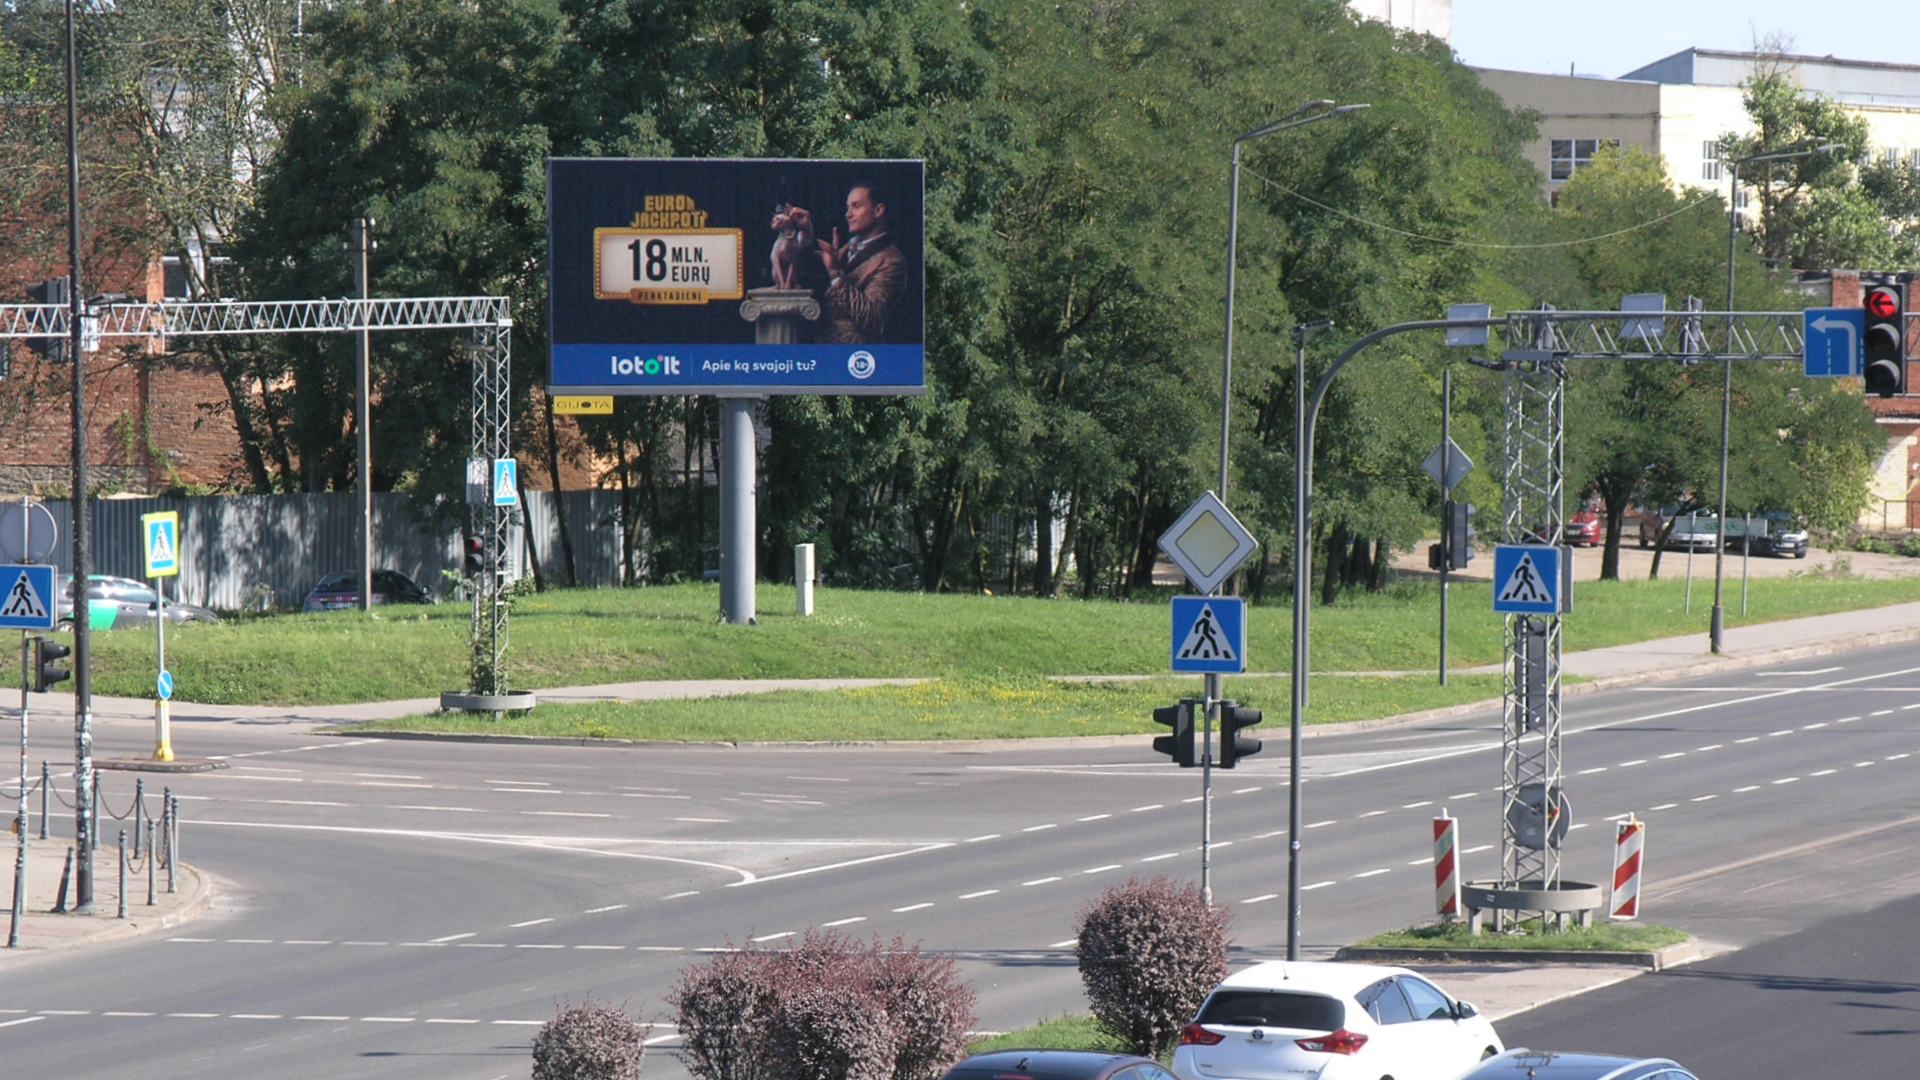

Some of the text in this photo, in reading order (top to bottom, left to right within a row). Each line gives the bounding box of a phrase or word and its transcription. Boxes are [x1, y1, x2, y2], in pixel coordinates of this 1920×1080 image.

[645, 195, 689, 212] EURO
[630, 211, 704, 229] JACKPOT
[627, 238, 668, 282] 18
[671, 247, 709, 263] MLN.
[671, 266, 710, 285] EURŲ
[702, 360, 817, 373] Apie ką svajoji tu?
